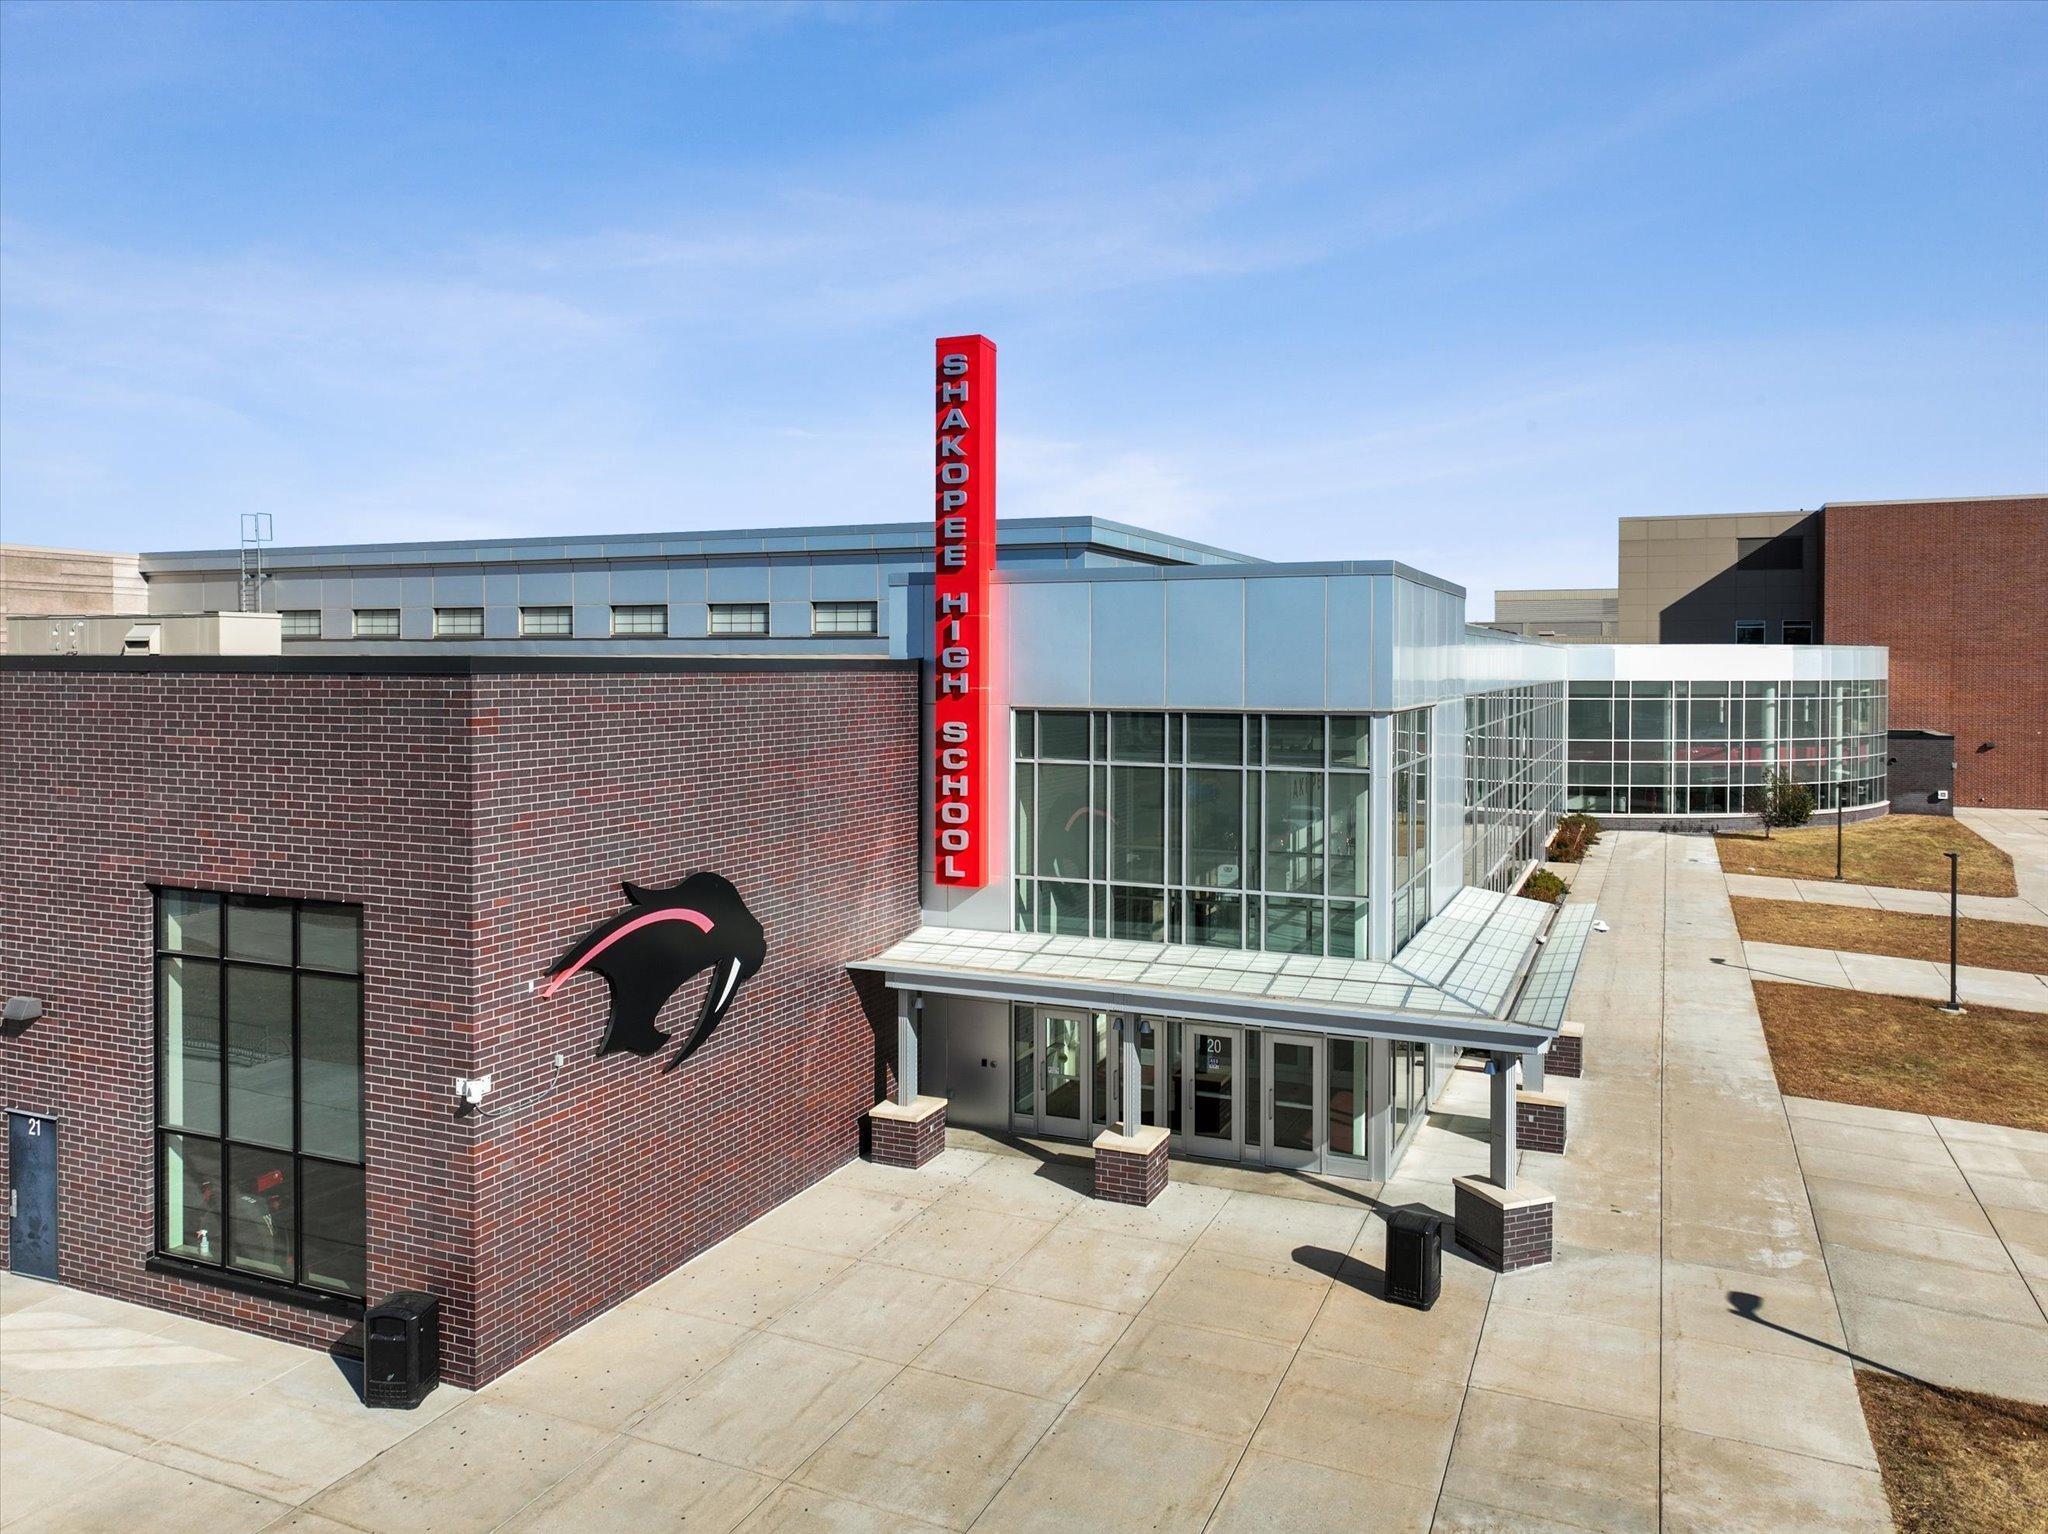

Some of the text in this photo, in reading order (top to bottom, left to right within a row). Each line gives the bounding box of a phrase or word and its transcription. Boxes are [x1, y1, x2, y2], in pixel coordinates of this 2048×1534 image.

[941, 353, 970, 878] SHAKOPEE HIGH SCHOOL
[1207, 1038, 1221, 1053] 20
[28, 1118, 41, 1136] 21
